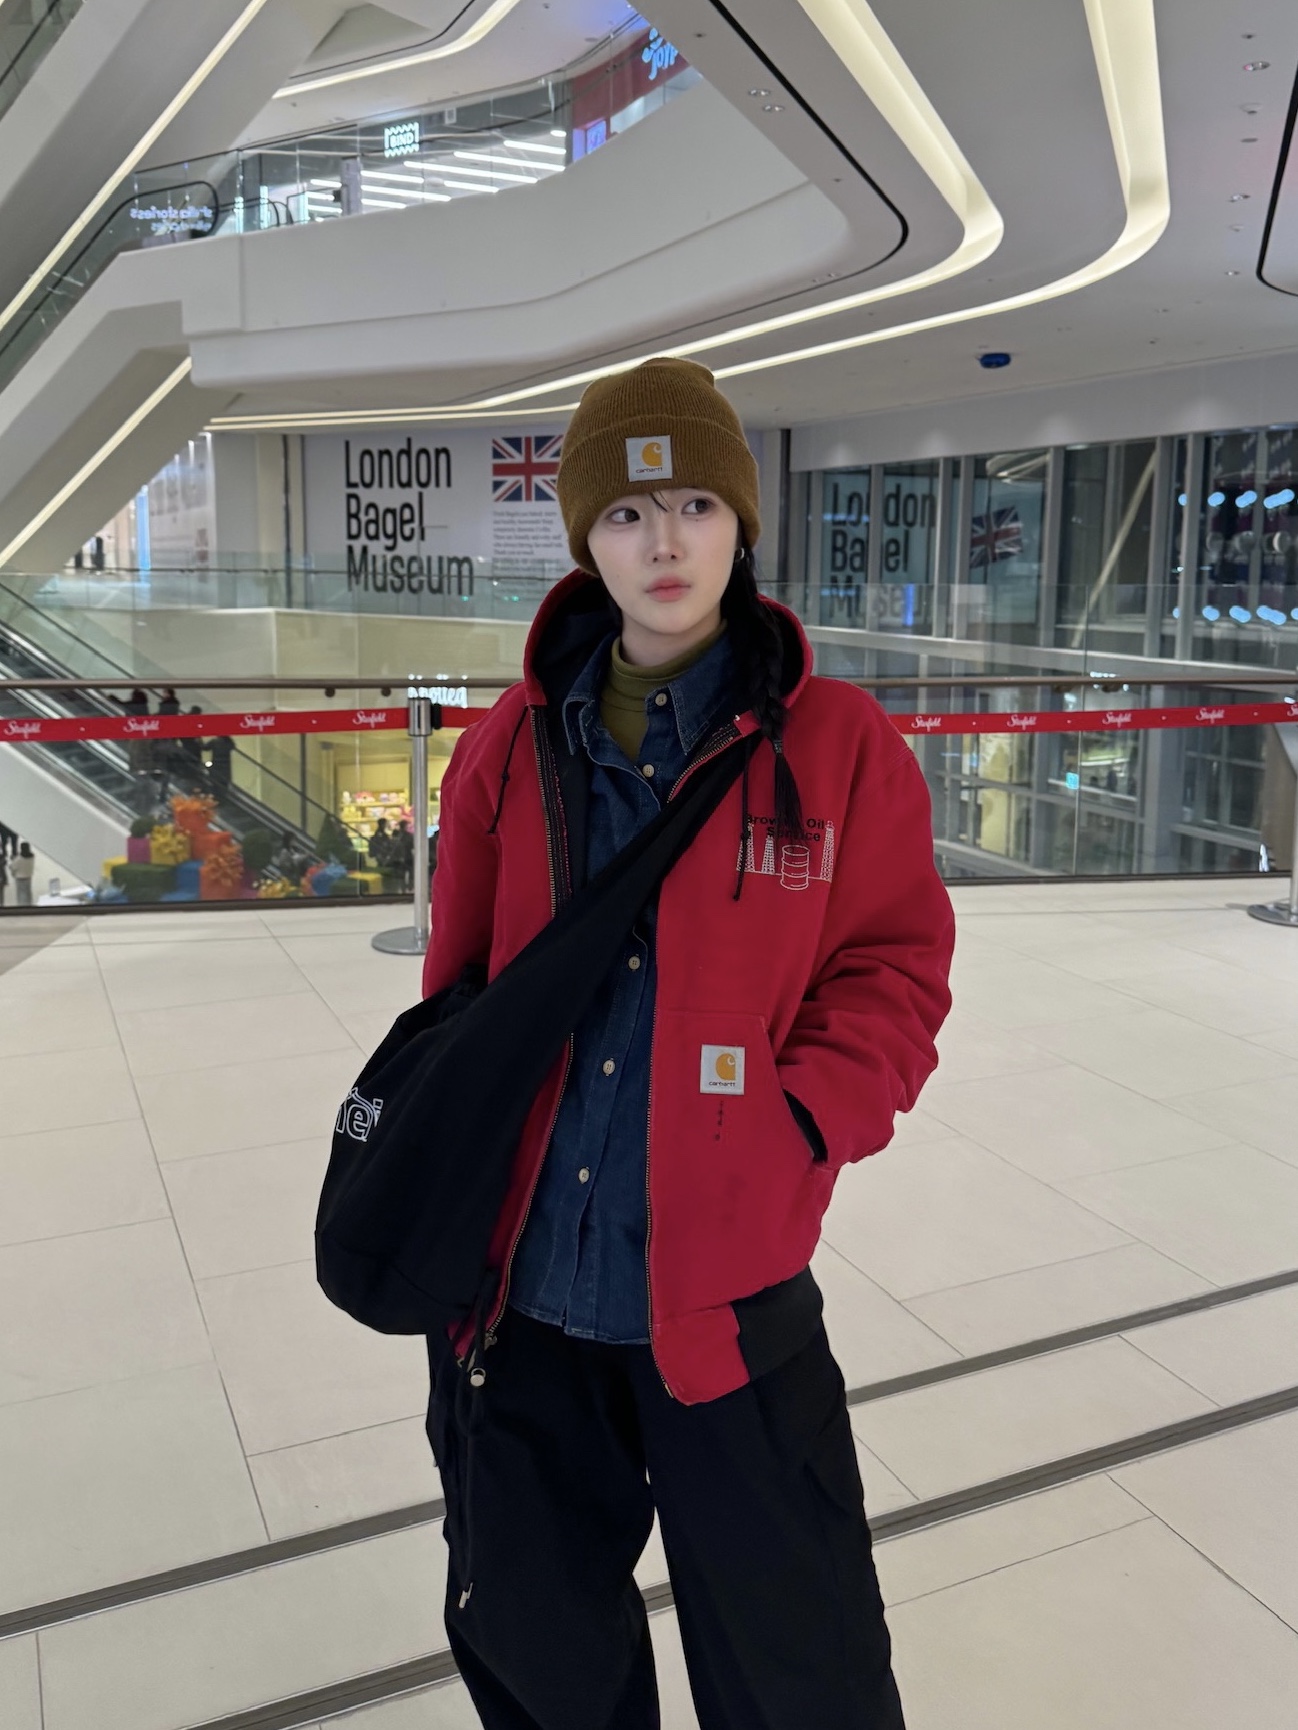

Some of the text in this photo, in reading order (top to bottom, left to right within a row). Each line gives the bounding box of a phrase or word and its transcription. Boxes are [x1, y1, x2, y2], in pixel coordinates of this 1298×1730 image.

[345, 437, 452, 489] London
[346, 492, 426, 551] Bagel
[347, 545, 474, 596] Museum
[830, 529, 910, 573] Bael
[806, 817, 825, 830] Oil
[708, 1080, 736, 1088] carhartt
